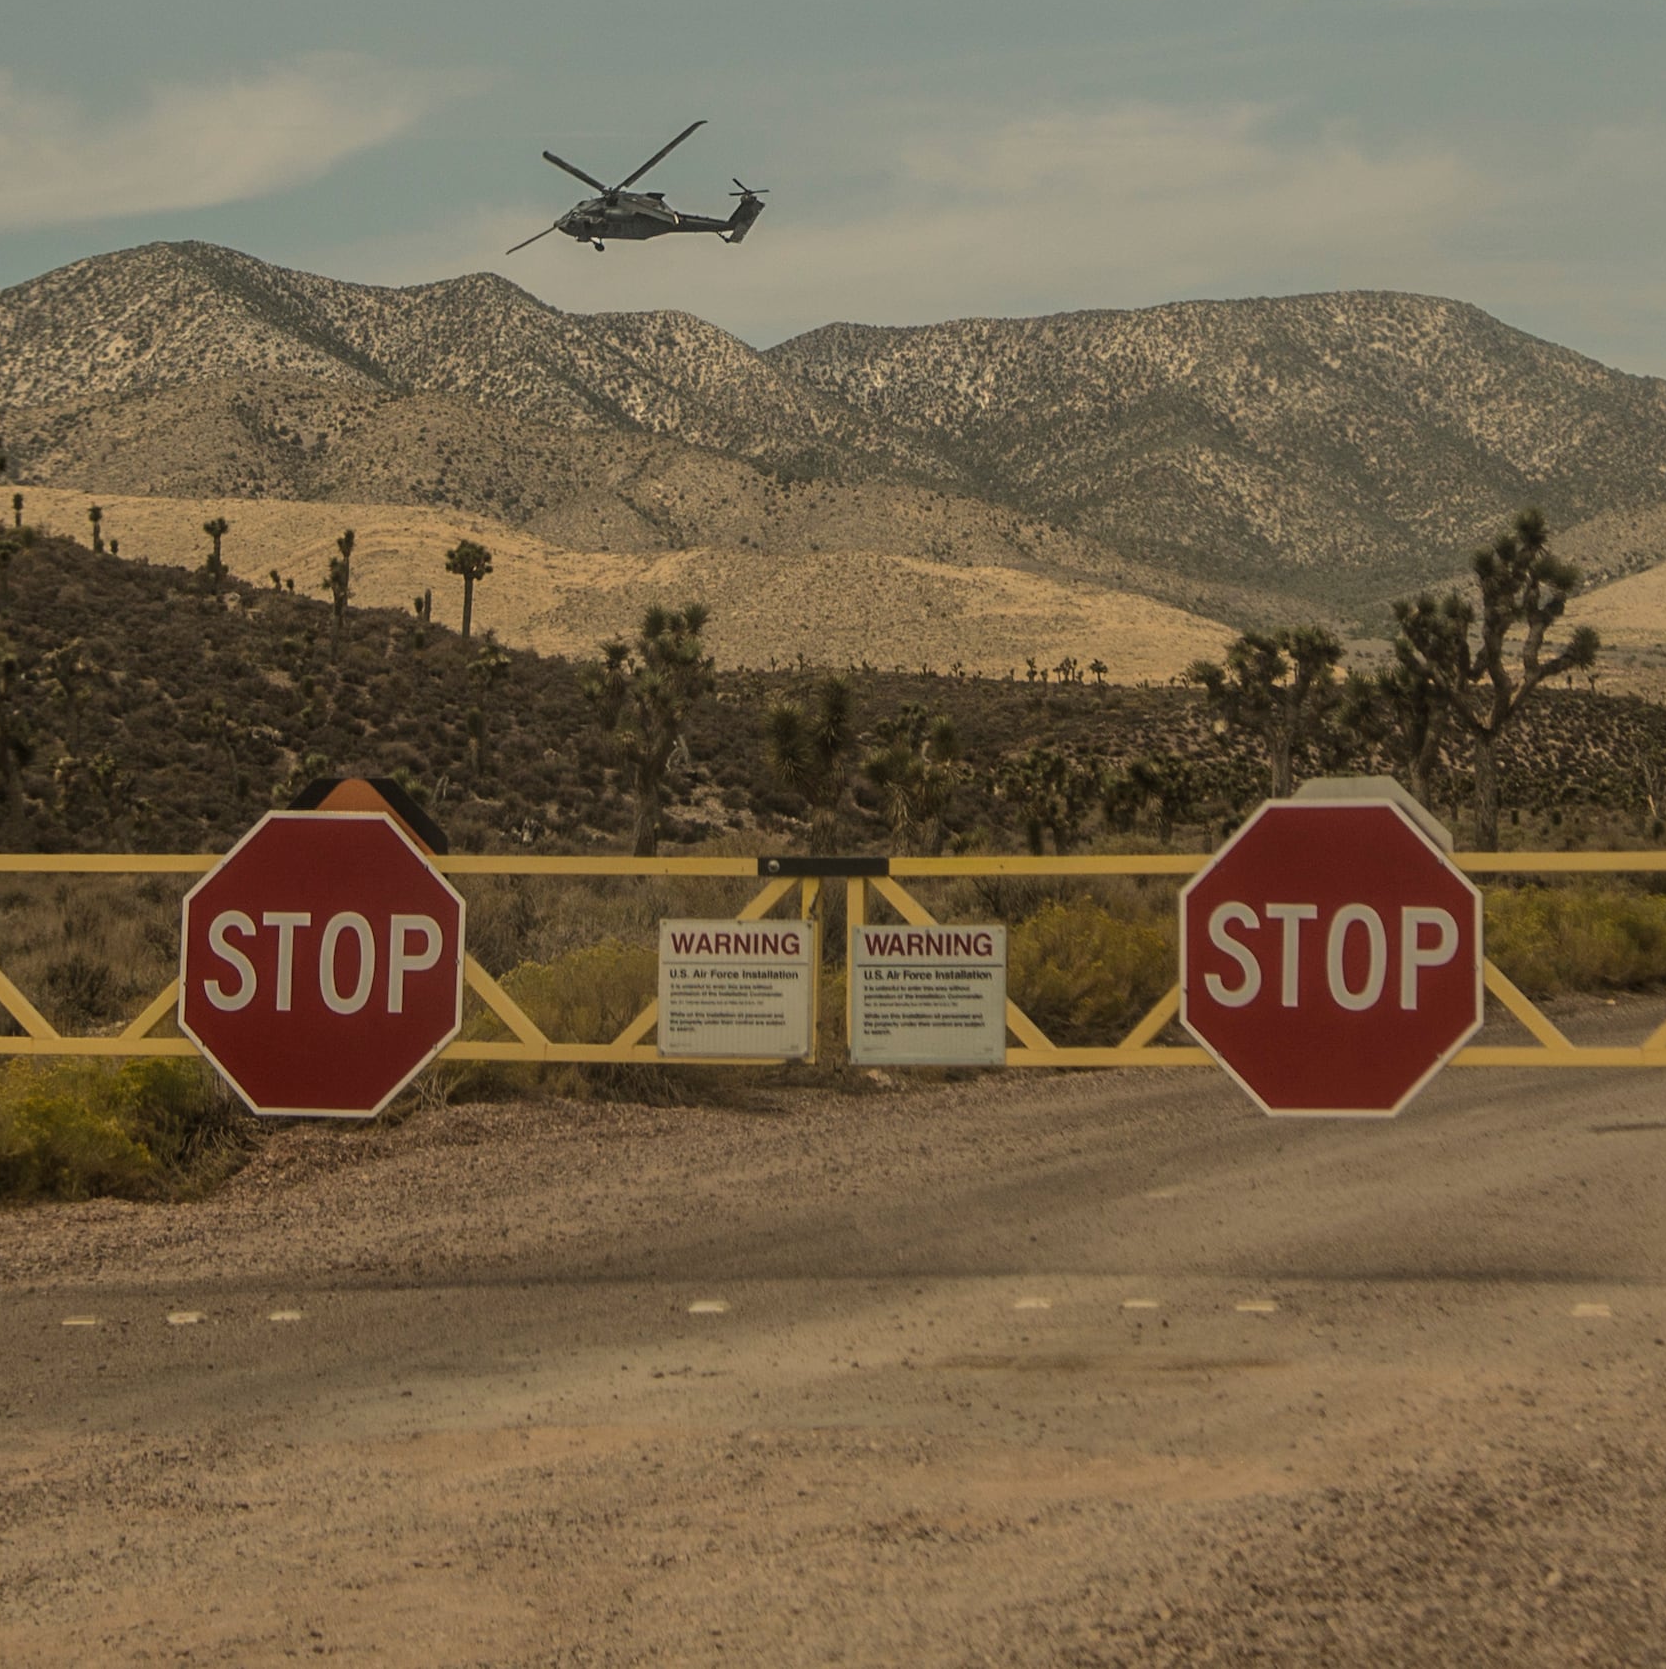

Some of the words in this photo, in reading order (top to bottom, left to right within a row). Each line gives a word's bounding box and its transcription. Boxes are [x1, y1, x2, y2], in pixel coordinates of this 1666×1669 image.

[671, 932, 800, 956] WARNING
[864, 932, 993, 956] WARNING
[1204, 900, 1459, 1011] STOP
[204, 909, 443, 1015] STOP
[669, 969, 690, 980] U.S.
[693, 969, 708, 980] Air
[710, 969, 740, 980] Force
[742, 969, 799, 980] Installation
[864, 970, 884, 980] U.S.
[886, 969, 900, 980] Air
[903, 970, 933, 980] Force
[935, 969, 993, 980] Installation
